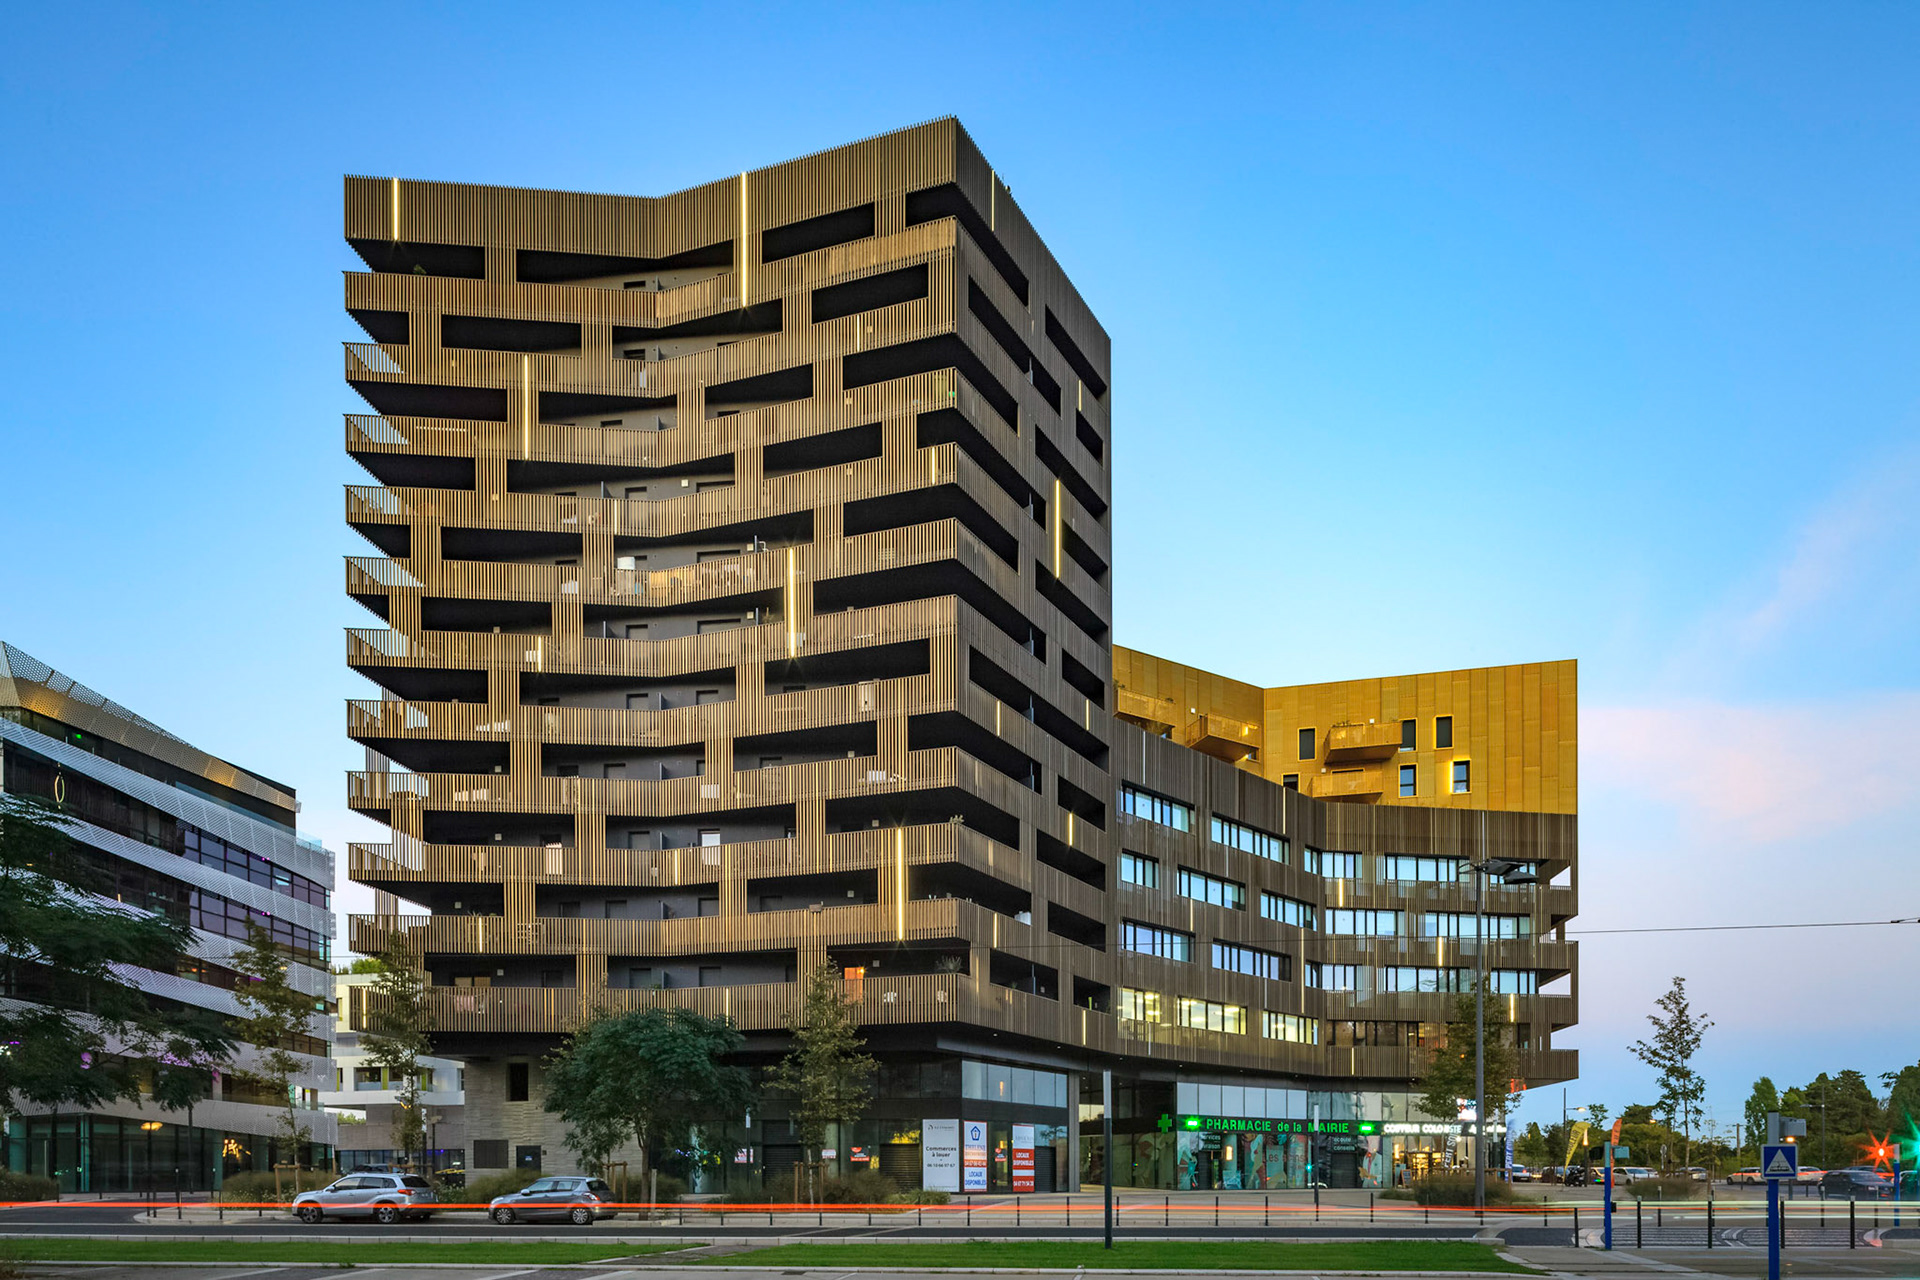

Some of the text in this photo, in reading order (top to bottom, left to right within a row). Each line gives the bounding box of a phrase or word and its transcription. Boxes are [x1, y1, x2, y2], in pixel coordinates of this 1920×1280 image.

[1206, 1118, 1349, 1133] PHARMACIE de la MAIRIE
[1383, 1123, 1420, 1133] COIFFEUR
